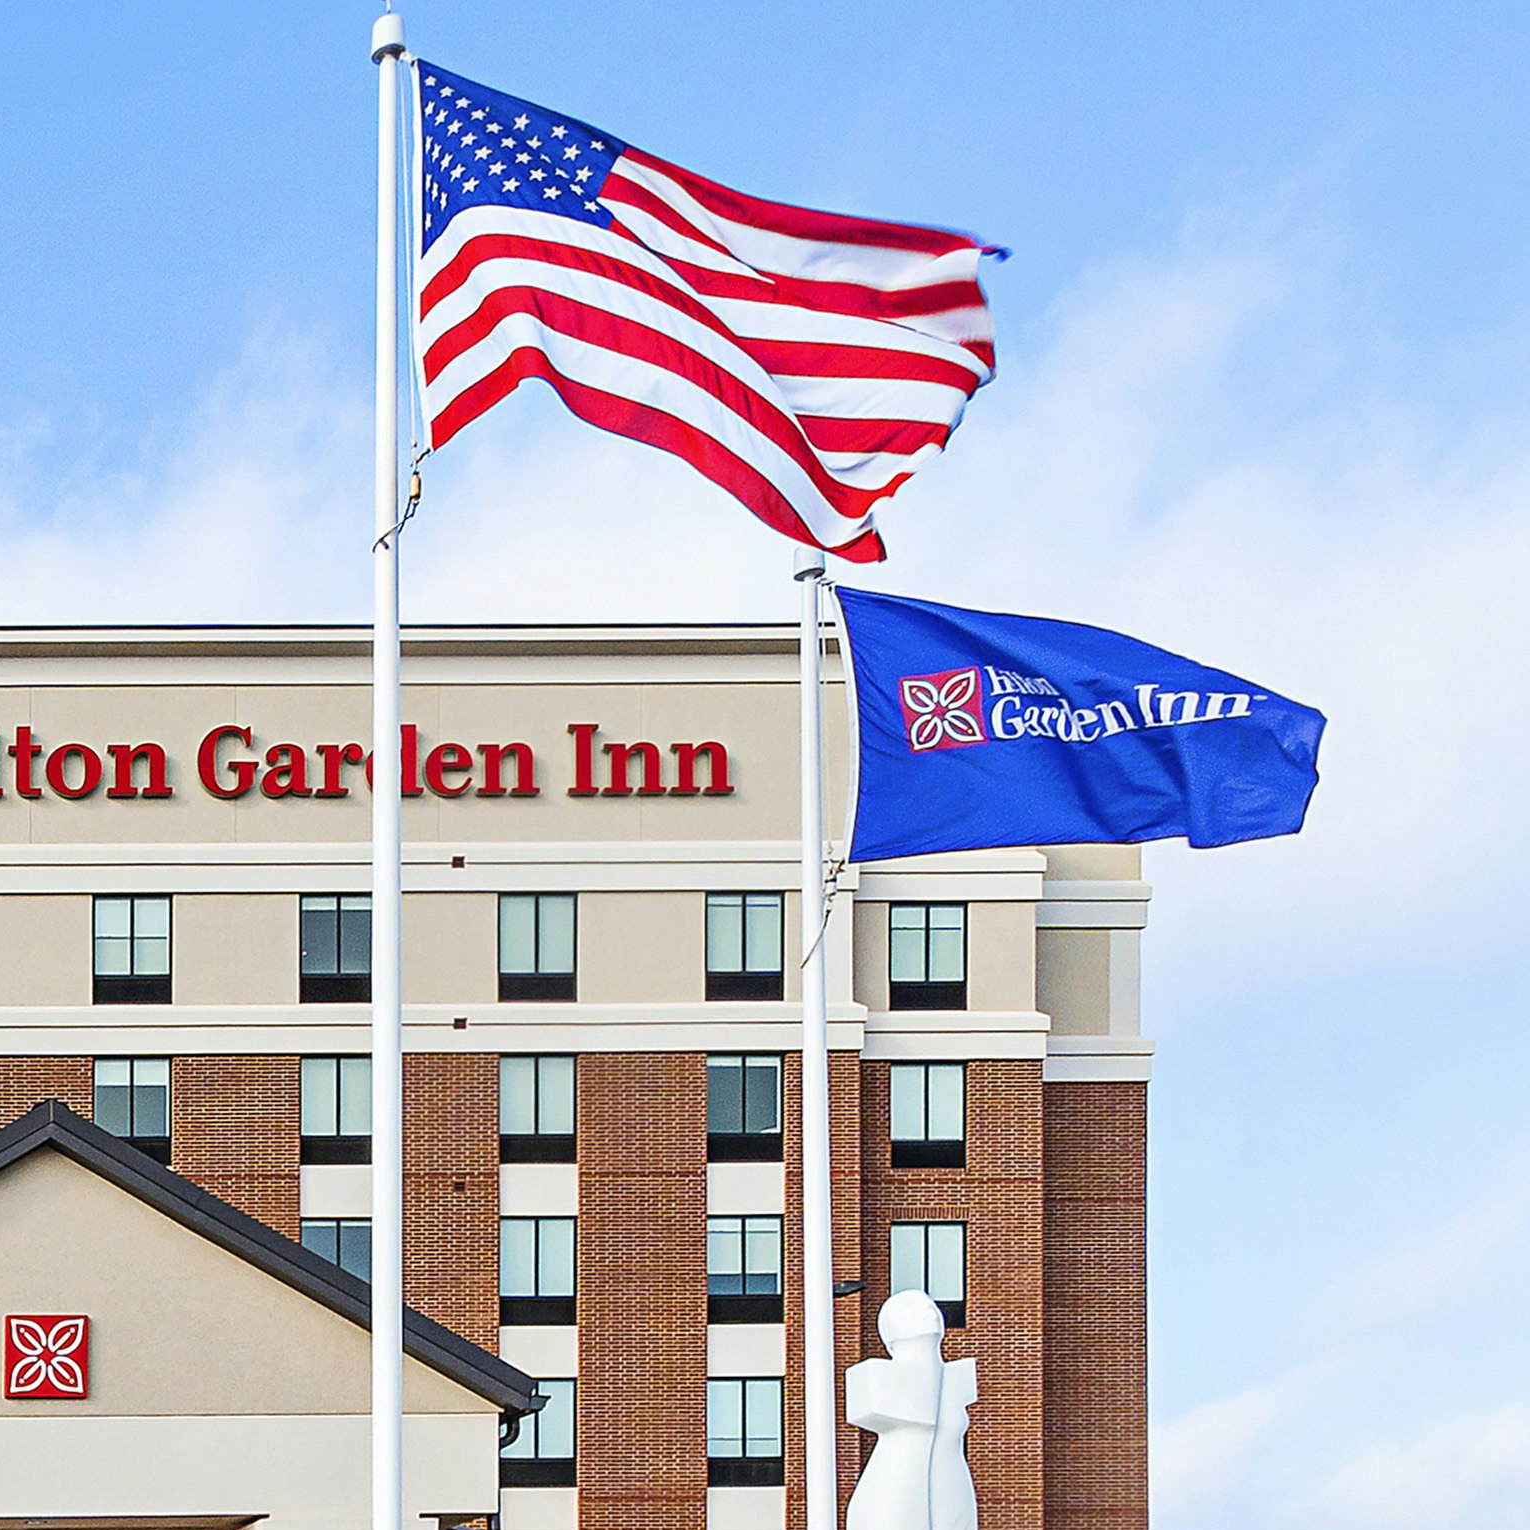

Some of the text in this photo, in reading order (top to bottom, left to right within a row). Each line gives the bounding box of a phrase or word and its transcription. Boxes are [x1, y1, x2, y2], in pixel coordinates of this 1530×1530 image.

[991, 684, 1252, 742] Garden Inn
[567, 723, 735, 797] Inn
